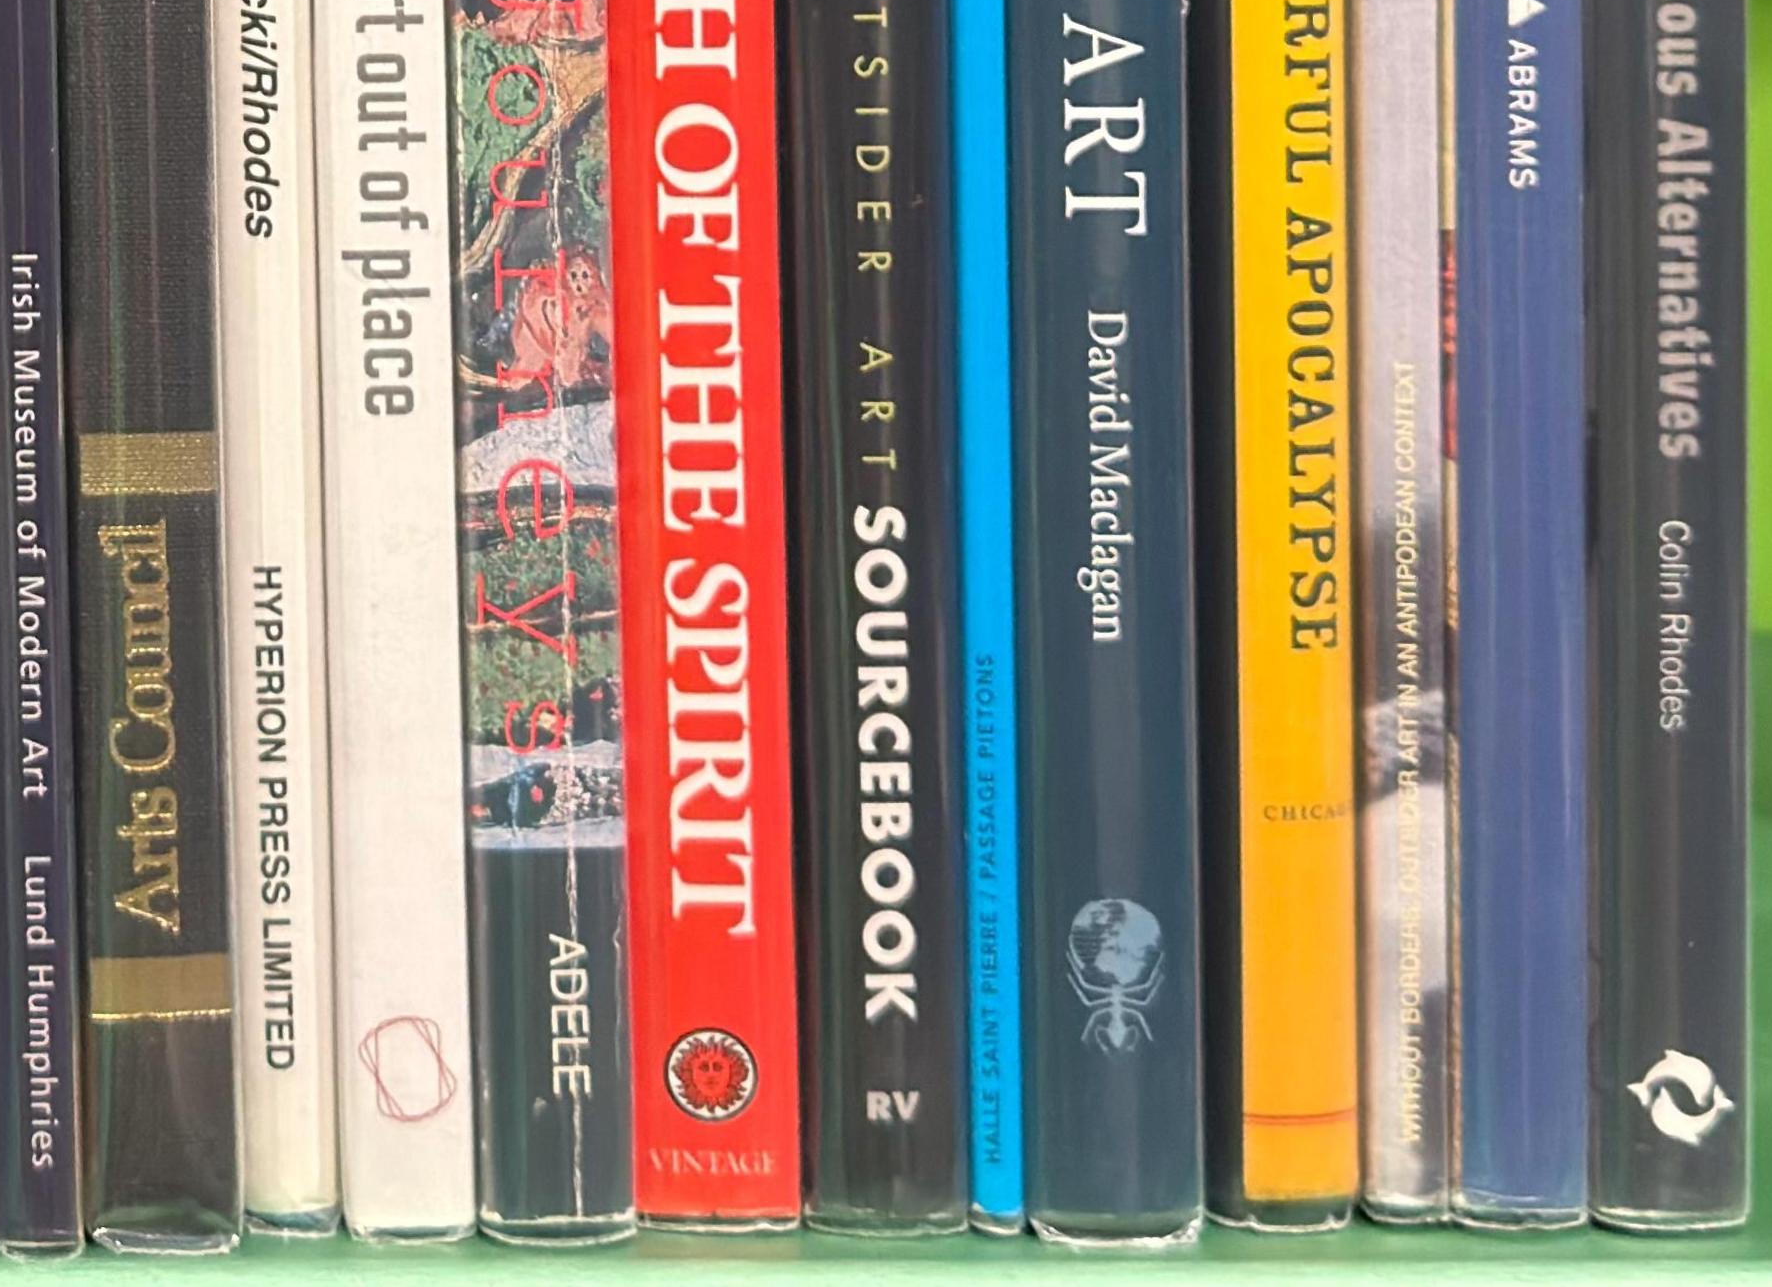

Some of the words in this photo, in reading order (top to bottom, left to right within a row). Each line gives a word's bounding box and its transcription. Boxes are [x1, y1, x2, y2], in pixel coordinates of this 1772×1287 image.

[357, 54, 424, 150] out
[655, 102, 740, 251] OF
[1062, 13, 1147, 235] ART
[1509, 40, 1539, 189] ABRAMS
[359, 170, 428, 230] of
[9, 254, 43, 332] Irish
[342, 249, 430, 417] place
[1658, 118, 1713, 458] Alternatives
[14, 350, 45, 502] Museum
[657, 277, 747, 529] THE
[861, 343, 897, 470] ART
[1283, 206, 1338, 652] APOCALYPSE
[16, 520, 48, 559] of
[18, 576, 52, 721] Modern
[98, 517, 176, 774] Council
[251, 565, 287, 763] HYPERION
[21, 736, 50, 799] Art
[663, 556, 754, 935] SPIRIT
[854, 504, 917, 1021] SOURCEBOOK
[115, 792, 180, 936] Arts
[257, 777, 292, 904] PRESS
[262, 919, 296, 1071] LIMITED
[550, 935, 589, 1096] ADELE
